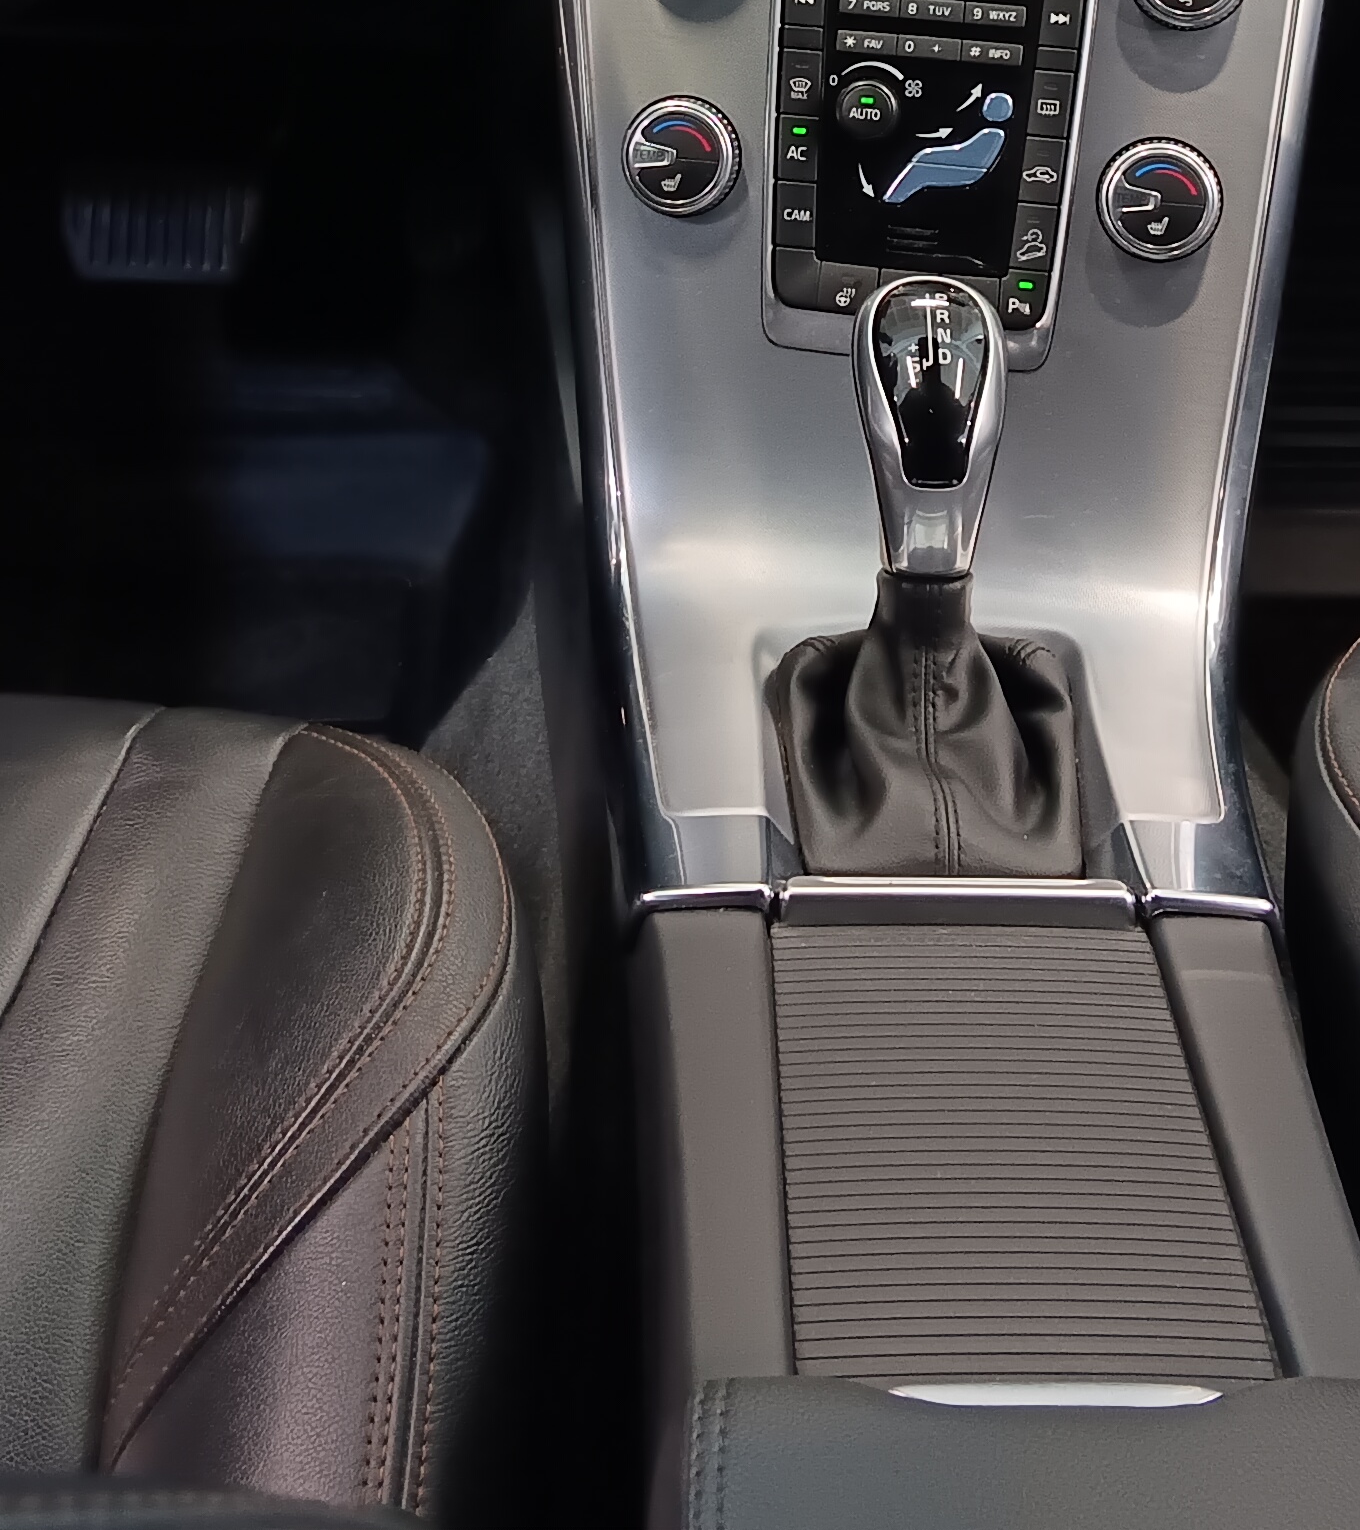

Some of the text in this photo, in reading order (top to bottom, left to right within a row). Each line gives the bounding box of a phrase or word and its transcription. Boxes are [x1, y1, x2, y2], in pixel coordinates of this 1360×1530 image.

[863, 0, 891, 13] PQRS
[907, 2, 952, 17] 8 TUV
[972, 7, 1017, 22] 9 WXYZ
[863, 38, 884, 50] FAV
[904, 40, 915, 53] 0
[988, 48, 1011, 60] INFO
[829, 74, 839, 87] 0
[791, 91, 808, 100] MAX
[849, 107, 881, 121] AUTO
[786, 145, 808, 161] AC
[783, 208, 811, 222] CAM
[935, 309, 950, 324] R
[936, 327, 952, 344] N
[937, 348, 952, 365] D
